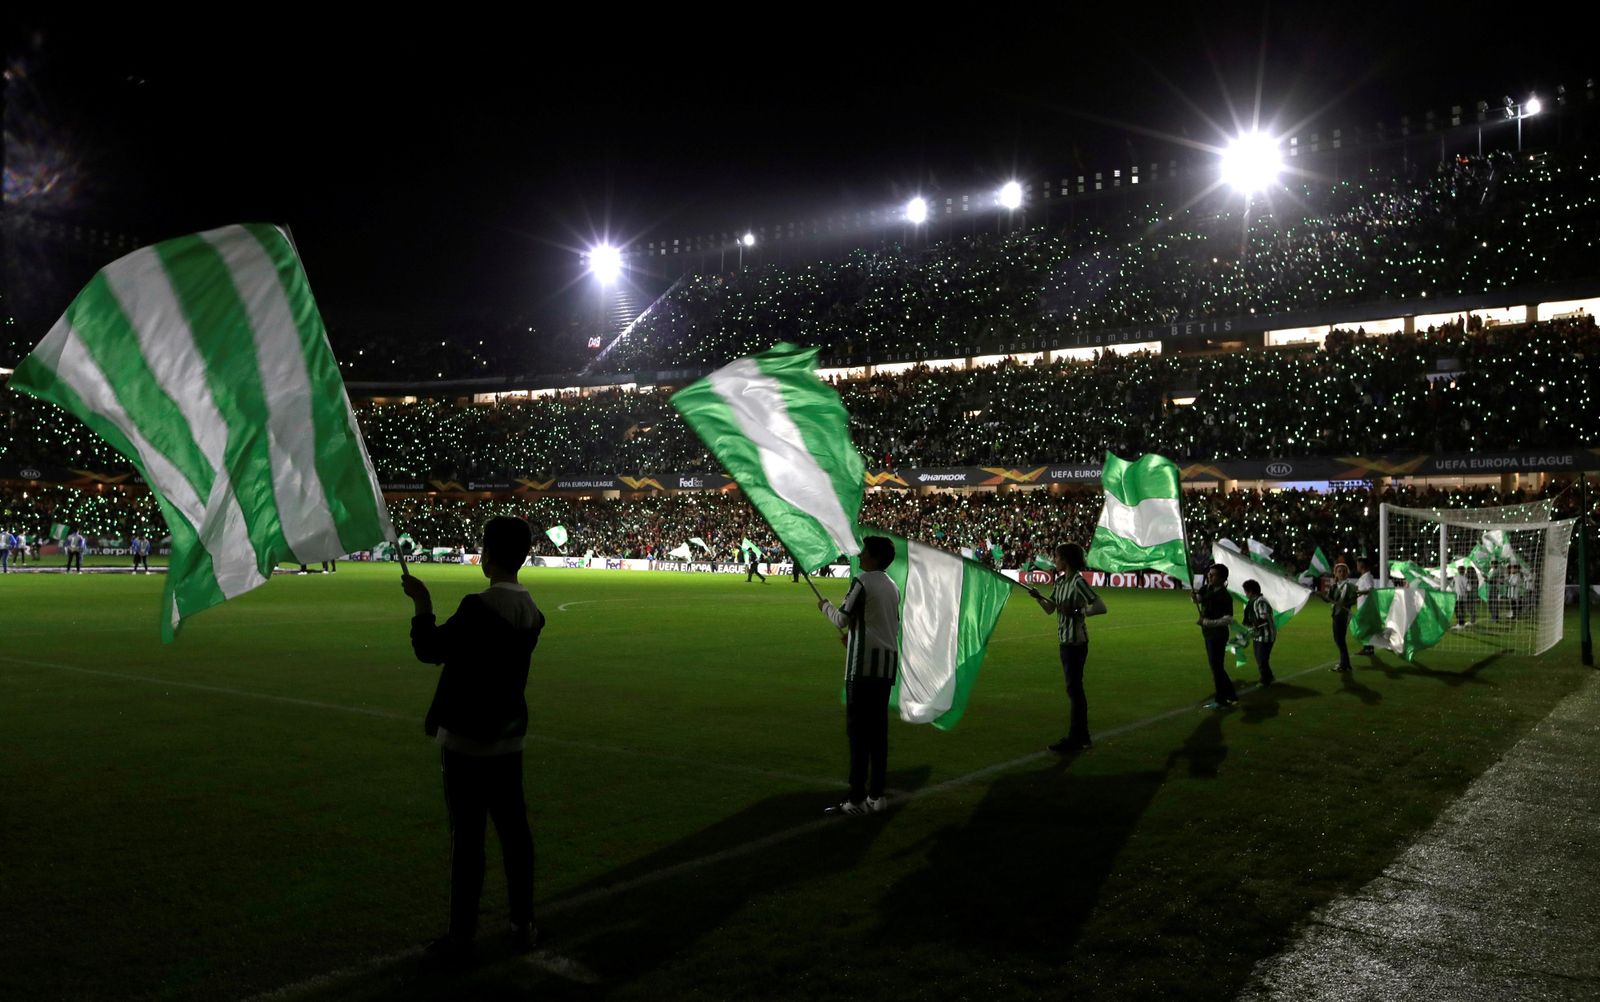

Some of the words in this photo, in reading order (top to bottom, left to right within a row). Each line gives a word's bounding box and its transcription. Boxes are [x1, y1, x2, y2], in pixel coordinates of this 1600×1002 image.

[1076, 330, 1155, 345] llamada
[1170, 320, 1232, 336] BETIS
[1435, 459, 1468, 470] UEFA
[1470, 457, 1519, 469] EUROPA
[1521, 455, 1574, 467] LEAGUE
[1051, 470, 1073, 479] UEFA
[1074, 469, 1103, 479] EUROP
[557, 480, 572, 489] UEFA
[572, 480, 593, 489] EUROPA
[593, 479, 615, 488] LEAGUE
[679, 477, 704, 488] FedEx
[606, 559, 633, 570] FedEx
[659, 561, 680, 571] UEFA
[1091, 571, 1176, 589] MOTORS
